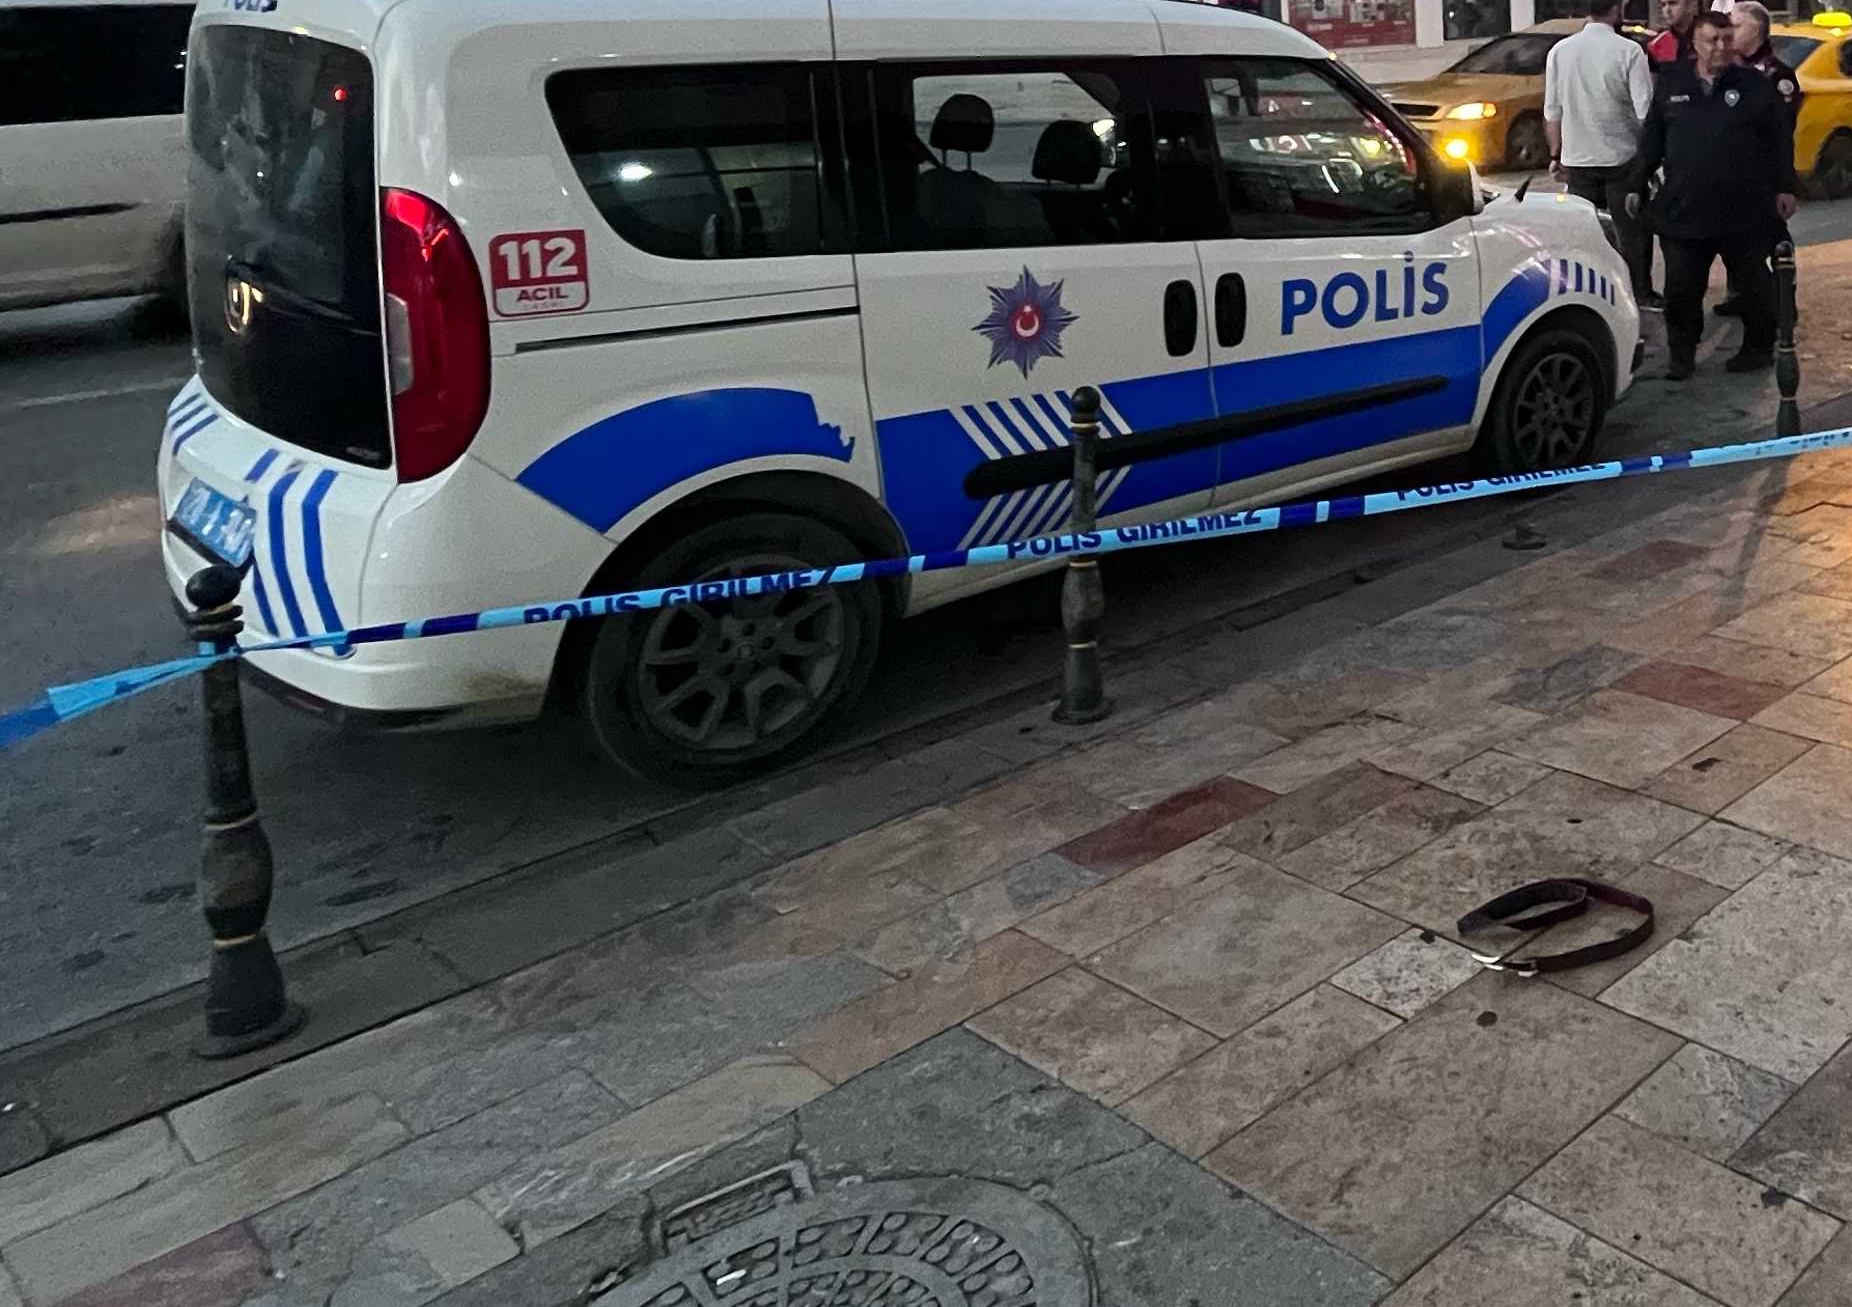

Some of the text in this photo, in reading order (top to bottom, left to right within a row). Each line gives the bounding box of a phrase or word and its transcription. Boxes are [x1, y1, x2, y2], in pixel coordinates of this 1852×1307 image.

[498, 236, 579, 281] 112
[516, 286, 569, 302] ACIL
[1281, 250, 1449, 336] POLİS
